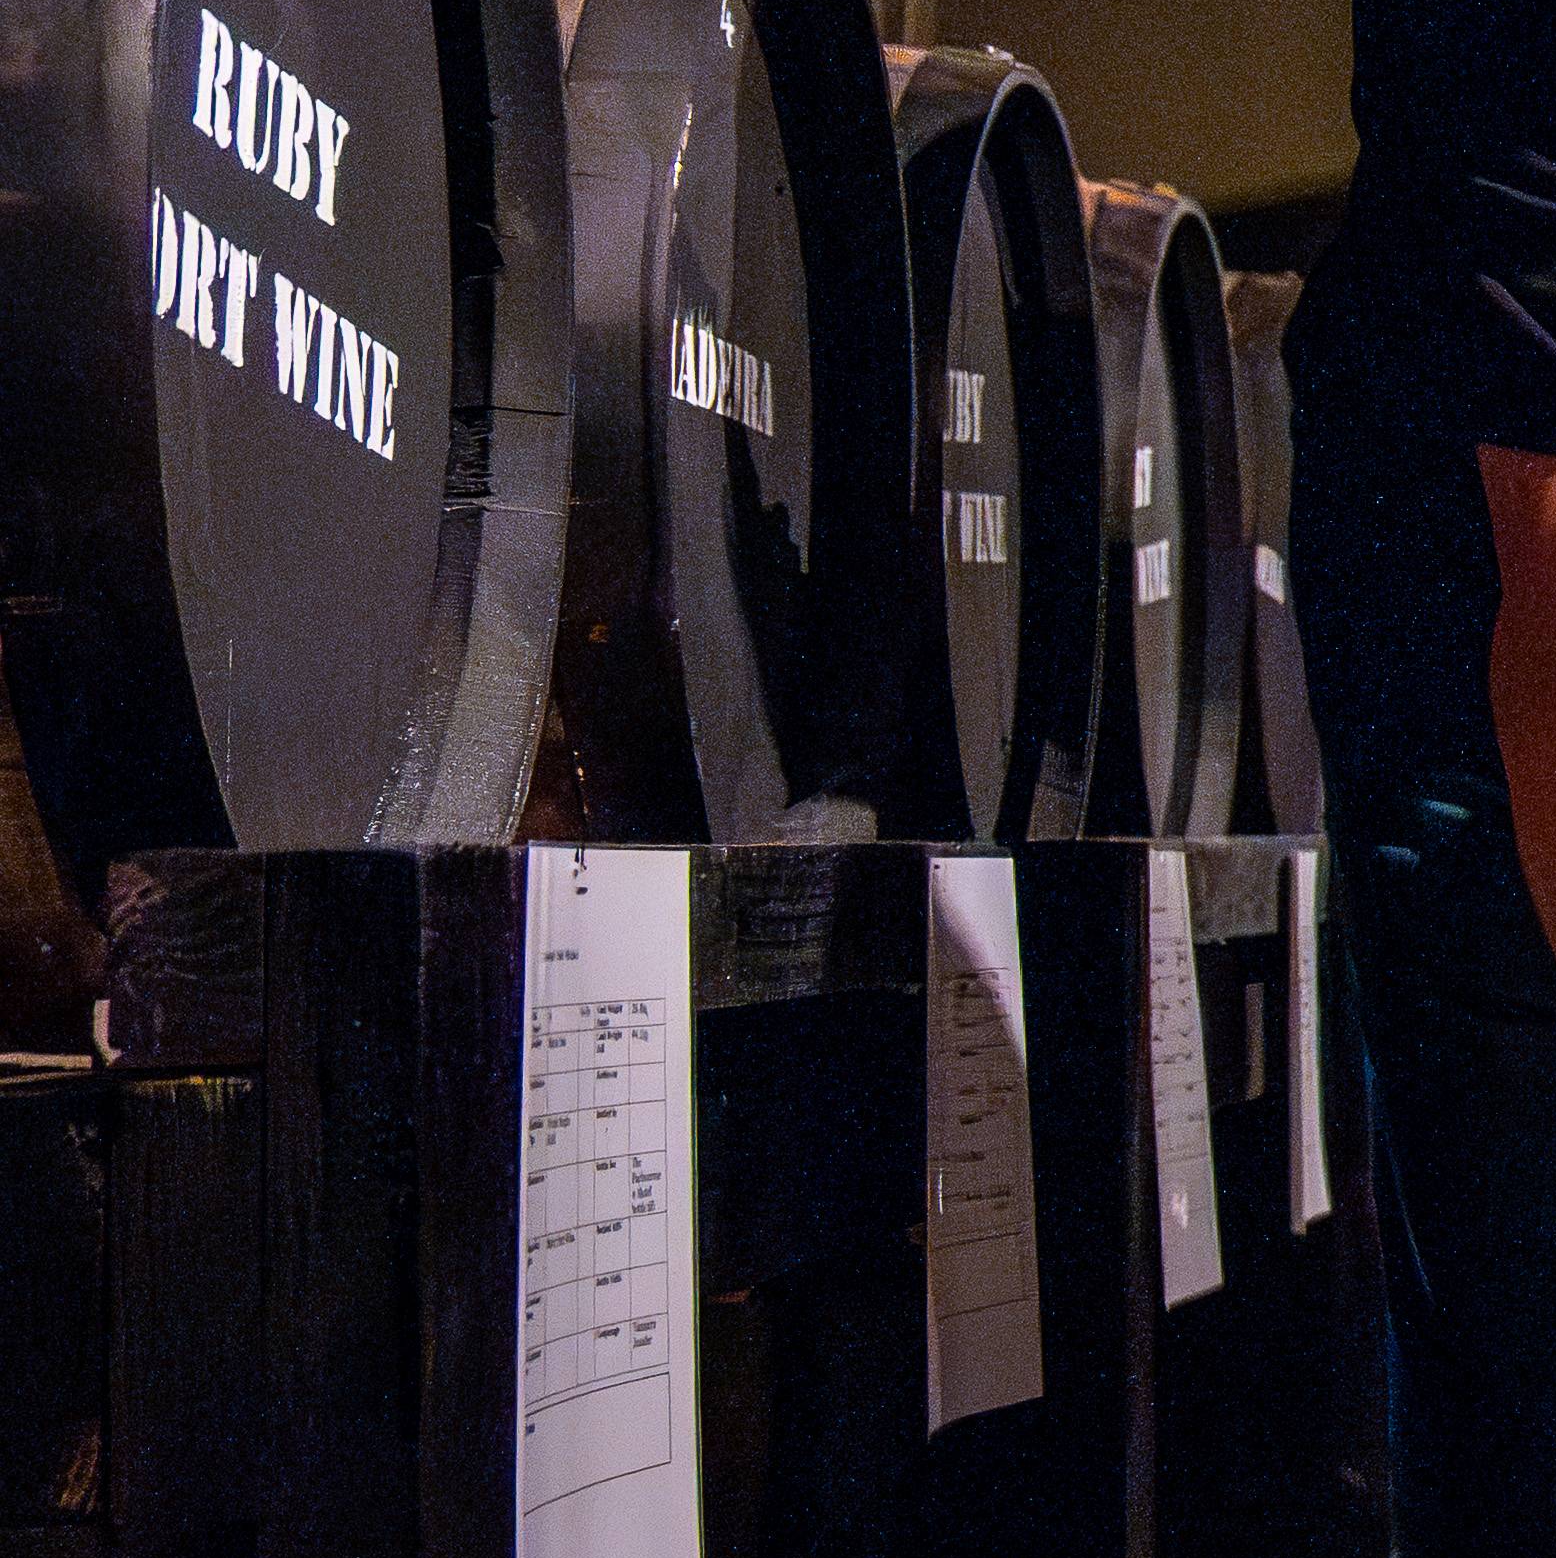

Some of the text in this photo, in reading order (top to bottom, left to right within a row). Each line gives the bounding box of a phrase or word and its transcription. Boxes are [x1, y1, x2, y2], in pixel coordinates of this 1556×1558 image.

[192, 7, 351, 227] RUBY
[152, 186, 400, 462] ORT WINE
[672, 318, 774, 437] ADEIRA
